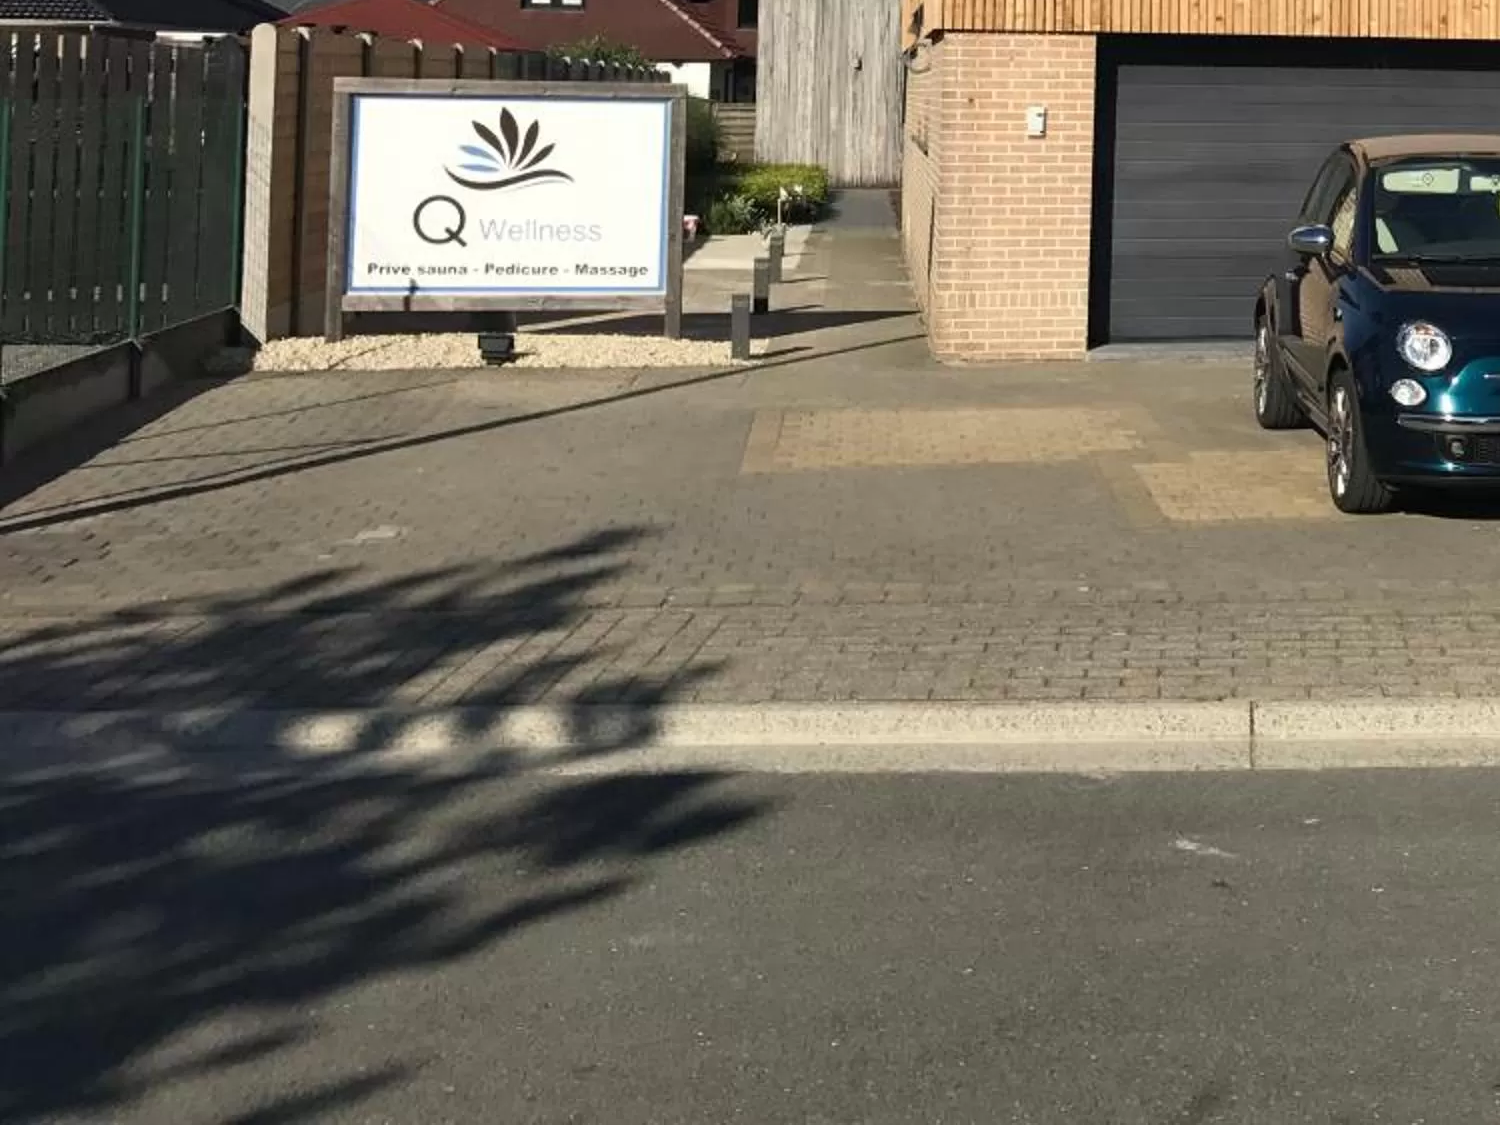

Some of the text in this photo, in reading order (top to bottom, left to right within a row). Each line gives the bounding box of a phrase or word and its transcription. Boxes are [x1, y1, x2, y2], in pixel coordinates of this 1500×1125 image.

[413, 195, 602, 247] Q Wellness
[417, 266, 467, 276] sauna
[484, 262, 559, 276] Pedicure
[575, 263, 649, 277] Massage
